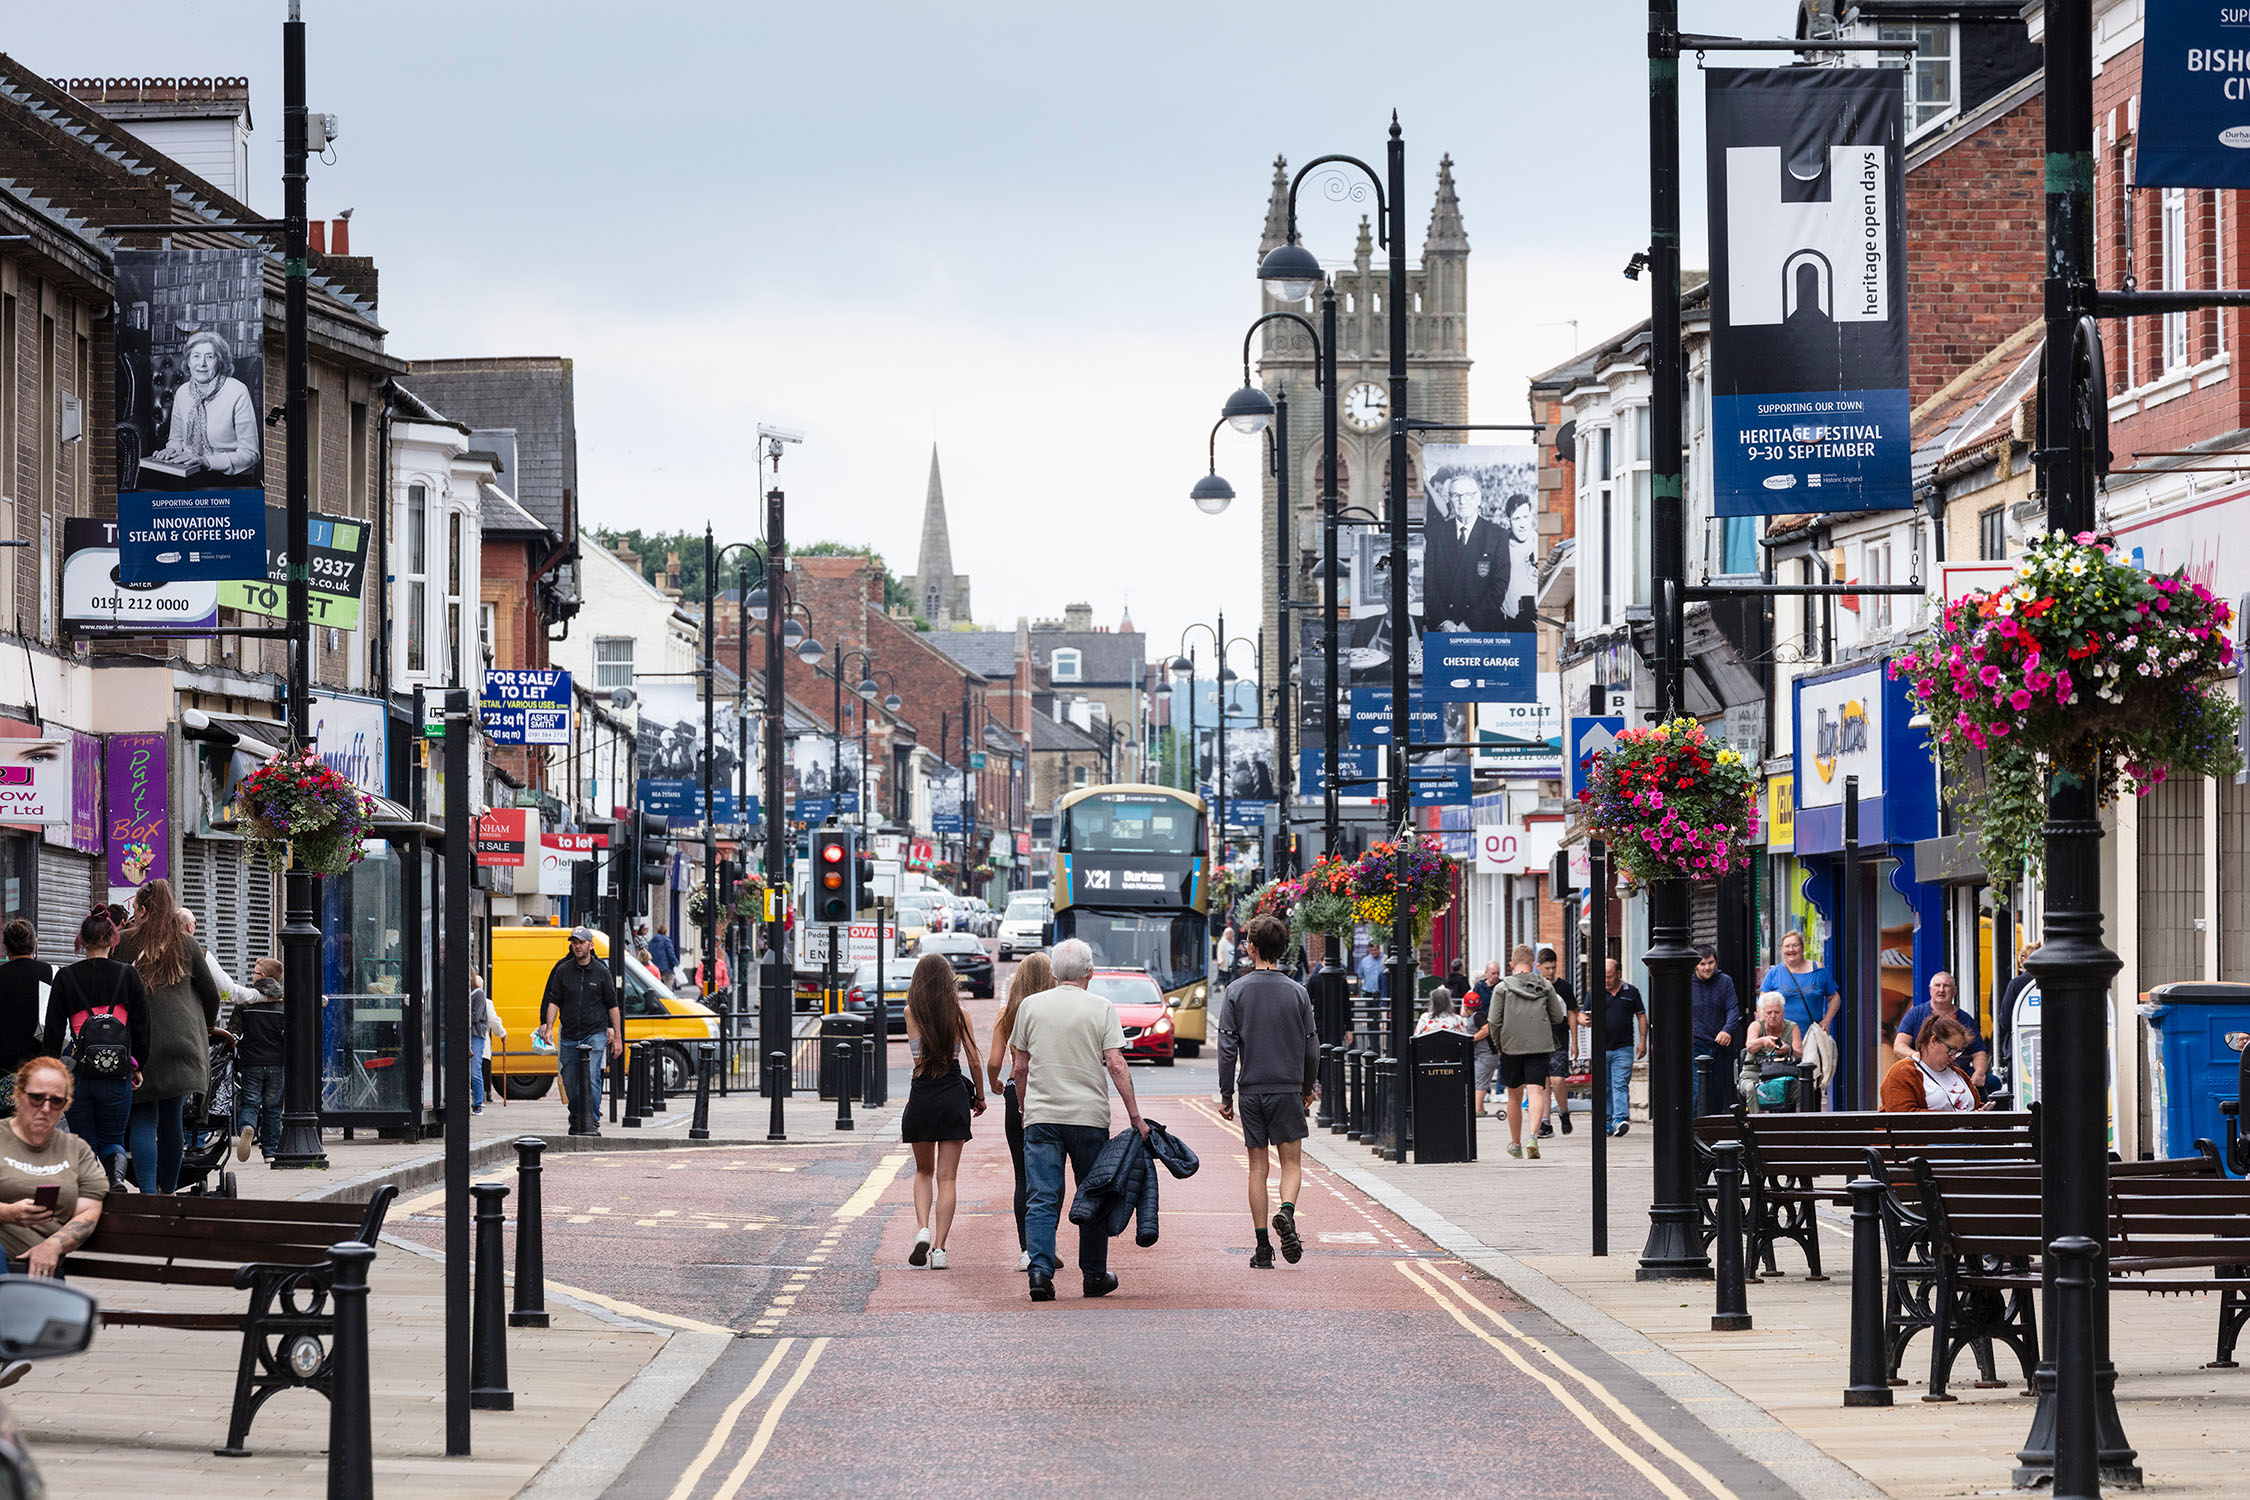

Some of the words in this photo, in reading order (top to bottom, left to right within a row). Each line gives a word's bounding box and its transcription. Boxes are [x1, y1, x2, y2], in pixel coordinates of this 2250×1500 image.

[2220, 8, 2250, 22] SUP
[2187, 48, 2250, 72] BISH
[1860, 152, 1880, 192] days
[1864, 195, 1880, 238] open
[1862, 241, 1881, 315] heritage
[1758, 403, 1812, 414] SUPPORTING
[1815, 402, 1834, 412] OUR
[1836, 401, 1862, 411] TOWN
[1740, 428, 1811, 444] HERITAGE
[1816, 425, 1882, 440] FESTIVAL
[1788, 443, 1876, 460] SEPTEMBER
[152, 499, 193, 507] SUPPORTING
[195, 498, 209, 506] OUR
[210, 498, 230, 506] TOWN
[152, 516, 231, 529] INNOVATIONS
[102, 523, 119, 544] T
[128, 530, 167, 542] STEAM
[170, 530, 179, 542] &
[182, 530, 222, 540] COFFEE
[224, 528, 256, 540] SHOP
[312, 556, 355, 578] 9337
[91, 596, 124, 610] 0191
[128, 598, 152, 610] 212
[156, 599, 190, 611] 0000
[242, 584, 278, 610] TO
[308, 596, 333, 619] ET
[1443, 657, 1480, 666] CHESTER
[1483, 657, 1520, 667] GARAGE
[486, 672, 516, 684] FOR
[518, 672, 560, 687] SALE/
[499, 686, 520, 698] TO
[522, 686, 548, 699] LET
[507, 700, 537, 709] VARIOUS
[538, 701, 555, 709] USES
[530, 714, 559, 722] ASHLEY
[1510, 708, 1526, 717] TO
[1530, 707, 1550, 716] LET
[502, 714, 514, 728] sq
[516, 712, 524, 726] ft
[119, 737, 155, 747] The
[129, 750, 150, 826] Party
[14, 805, 44, 815] Ltd
[486, 842, 510, 851] SALE
[558, 836, 572, 848] to
[576, 836, 594, 848] let
[1486, 836, 1516, 852] on
[1084, 869, 1110, 889] X21
[810, 950, 842, 960] ENS
